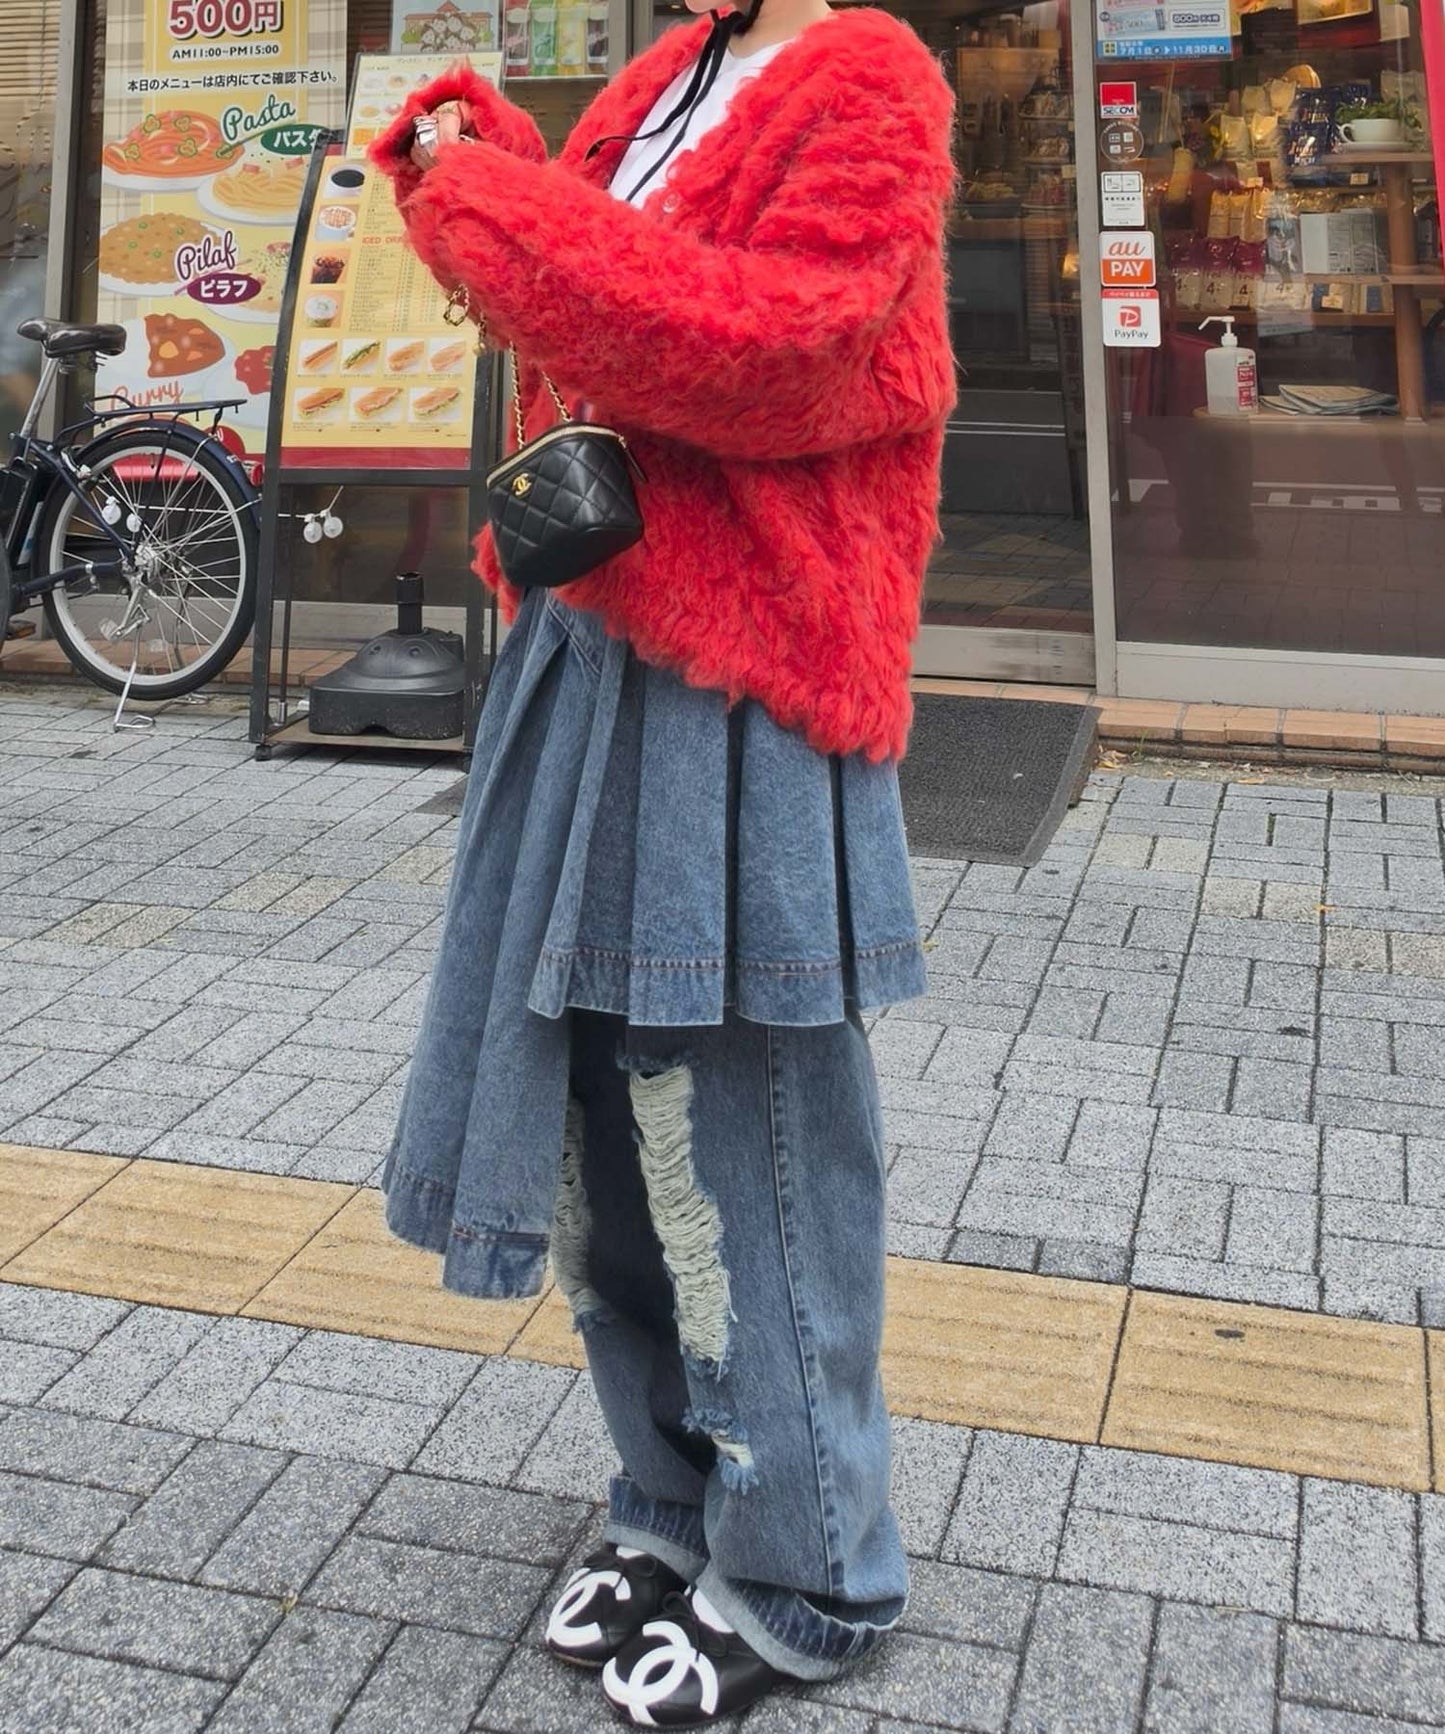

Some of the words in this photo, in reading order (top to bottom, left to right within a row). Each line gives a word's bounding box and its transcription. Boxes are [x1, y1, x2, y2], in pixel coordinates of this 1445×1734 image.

[169, 0, 281, 37] 500円
[127, 70, 338, 92] 本日のメニューは店内にてご確認下さい。
[222, 94, 296, 141] Pasta
[1103, 106, 1134, 115] SECOM
[177, 231, 236, 280] Pilaf
[1108, 241, 1146, 256] au
[1110, 261, 1145, 277] PAY
[201, 279, 248, 298] ピラフ
[1114, 329, 1148, 339] PayPay
